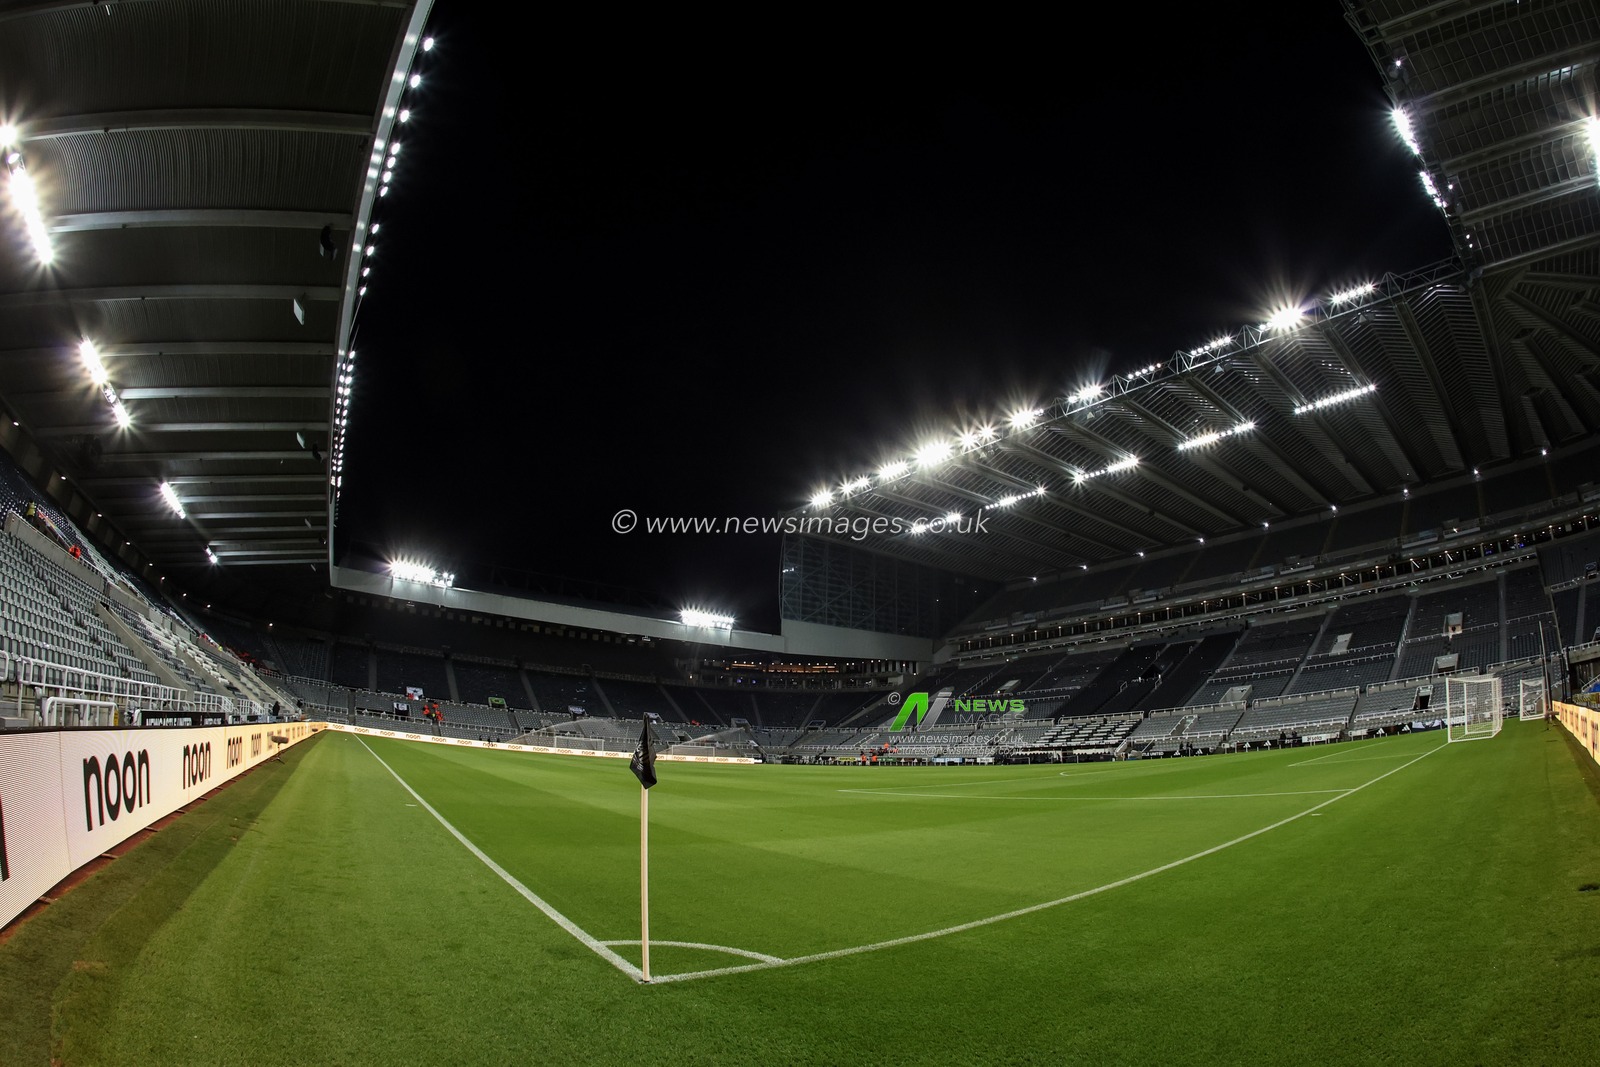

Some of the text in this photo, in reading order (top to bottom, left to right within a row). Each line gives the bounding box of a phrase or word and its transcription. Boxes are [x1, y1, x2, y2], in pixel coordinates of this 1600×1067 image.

[183, 741, 211, 789] noon
[227, 736, 242, 769] noon
[83, 749, 151, 832] noon
